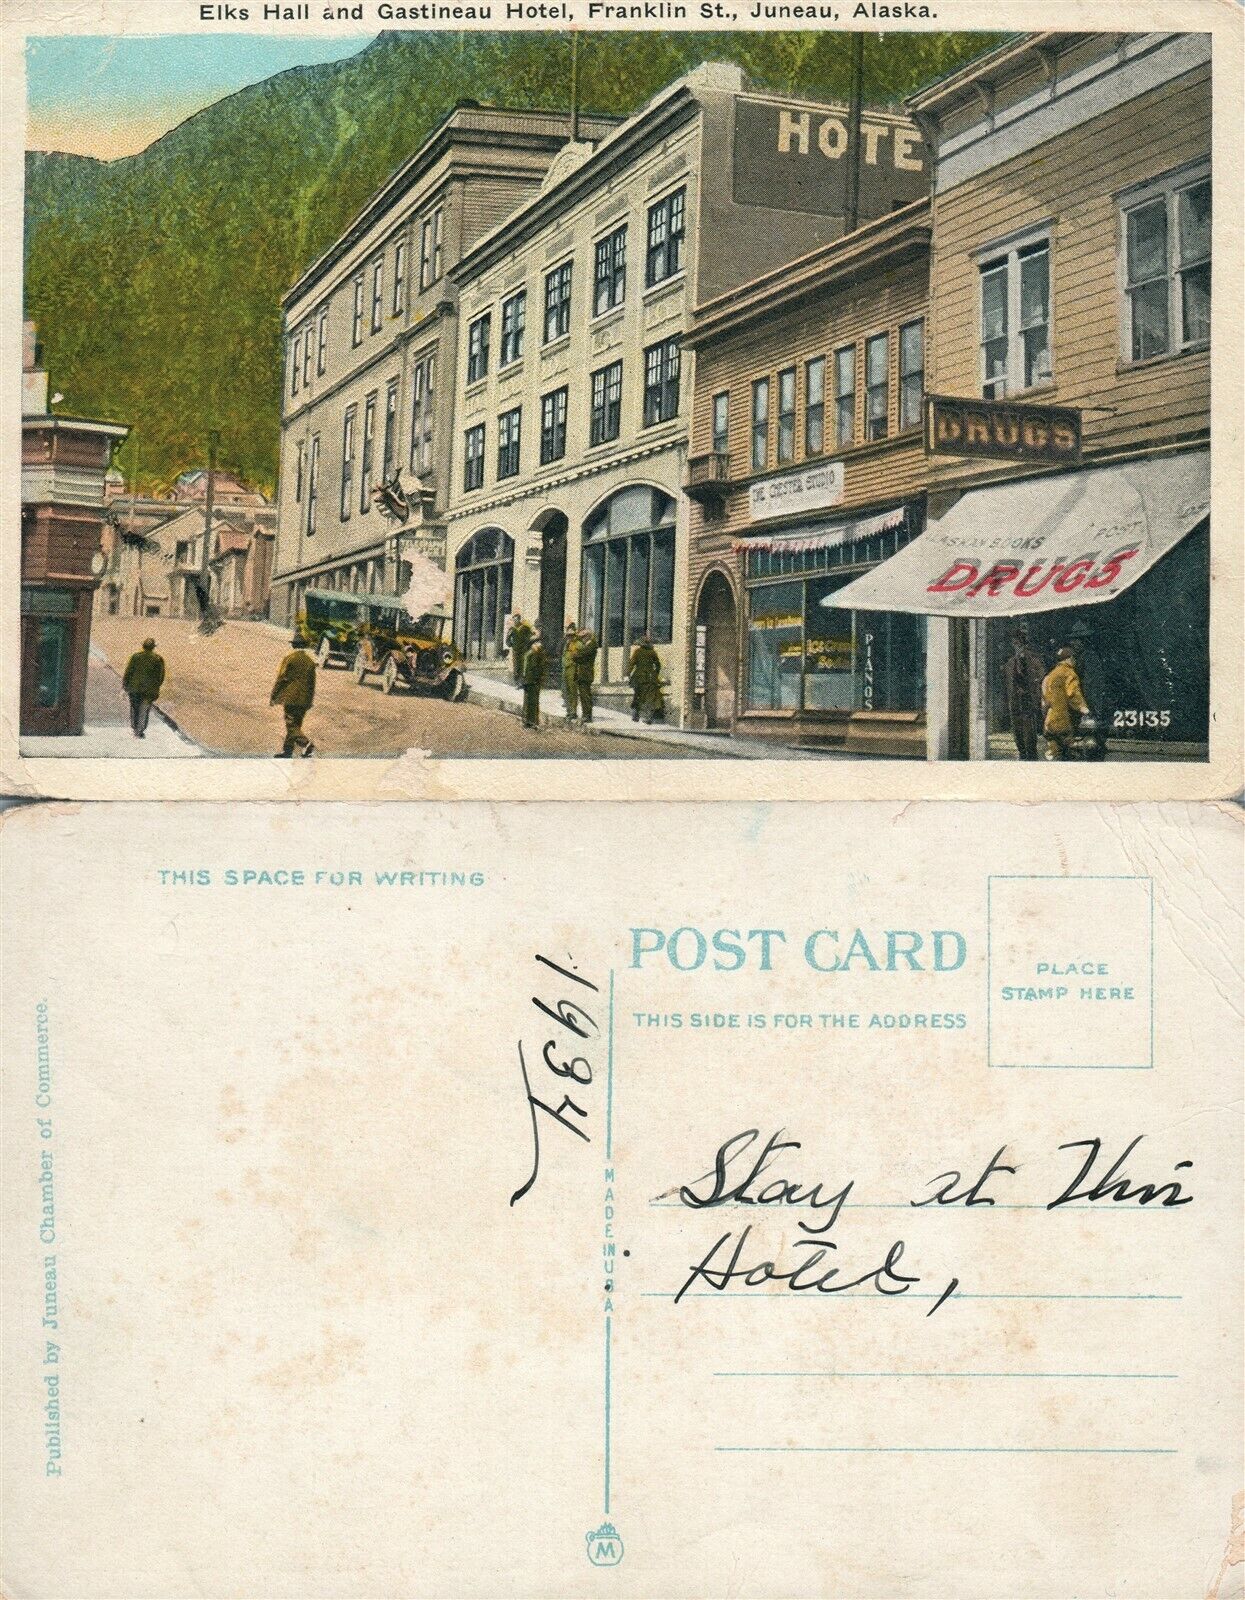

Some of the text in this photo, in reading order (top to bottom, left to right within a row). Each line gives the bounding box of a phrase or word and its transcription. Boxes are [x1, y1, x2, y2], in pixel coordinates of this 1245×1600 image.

[200, 2, 938, 21] Elks Hall and Gastineau Hotel, Franklin St., Juneau, Alaska.
[936, 407, 1077, 449] DRUGS
[805, 469, 835, 490] STUDIO
[989, 536, 1046, 550] BOOKS
[926, 543, 1141, 597] DRUGS
[863, 633, 875, 711] PIANOS
[1113, 710, 1171, 728] 23135
[159, 869, 486, 887] THIS SPACE FOR WRITING
[629, 926, 968, 973] POST CARD
[1036, 961, 1109, 977] PLACE
[1000, 985, 1134, 1001] STAMP HERE
[633, 1013, 967, 1029] THIS SIDE IS FOR THE ADDRESS
[520, 952, 600, 1146] 1934
[675, 1127, 855, 1233] Stay
[910, 1145, 1016, 1207] at
[604, 1168, 615, 1238] MADE
[35, 998, 62, 1478] Published by Juneau Chamber of Commerce.
[602, 1243, 616, 1256] IN
[595, 1542, 616, 1559] M
